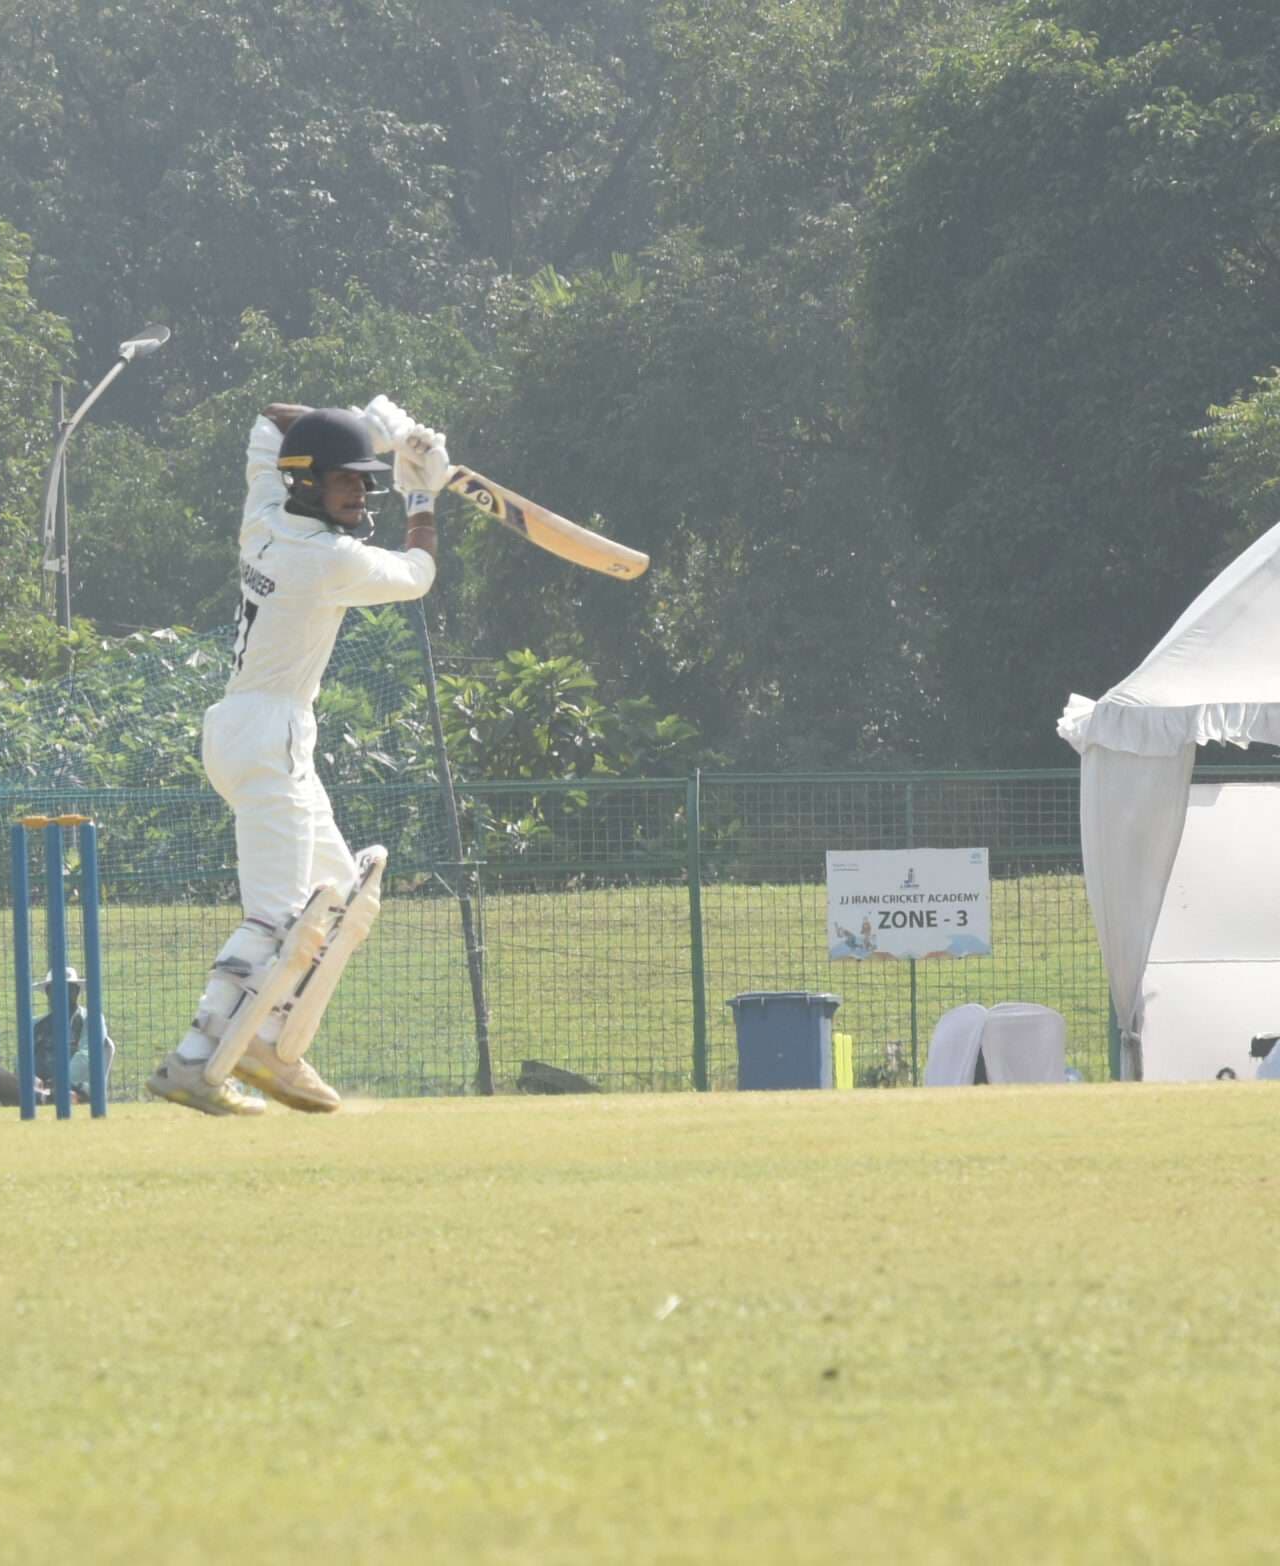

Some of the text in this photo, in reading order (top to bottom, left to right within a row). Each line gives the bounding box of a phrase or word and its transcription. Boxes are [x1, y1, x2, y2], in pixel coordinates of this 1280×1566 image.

[839, 893, 980, 906] JJ IRANI CRICKET ACADEMY
[878, 910, 938, 929] ZONE
[956, 909, 969, 927] 3
